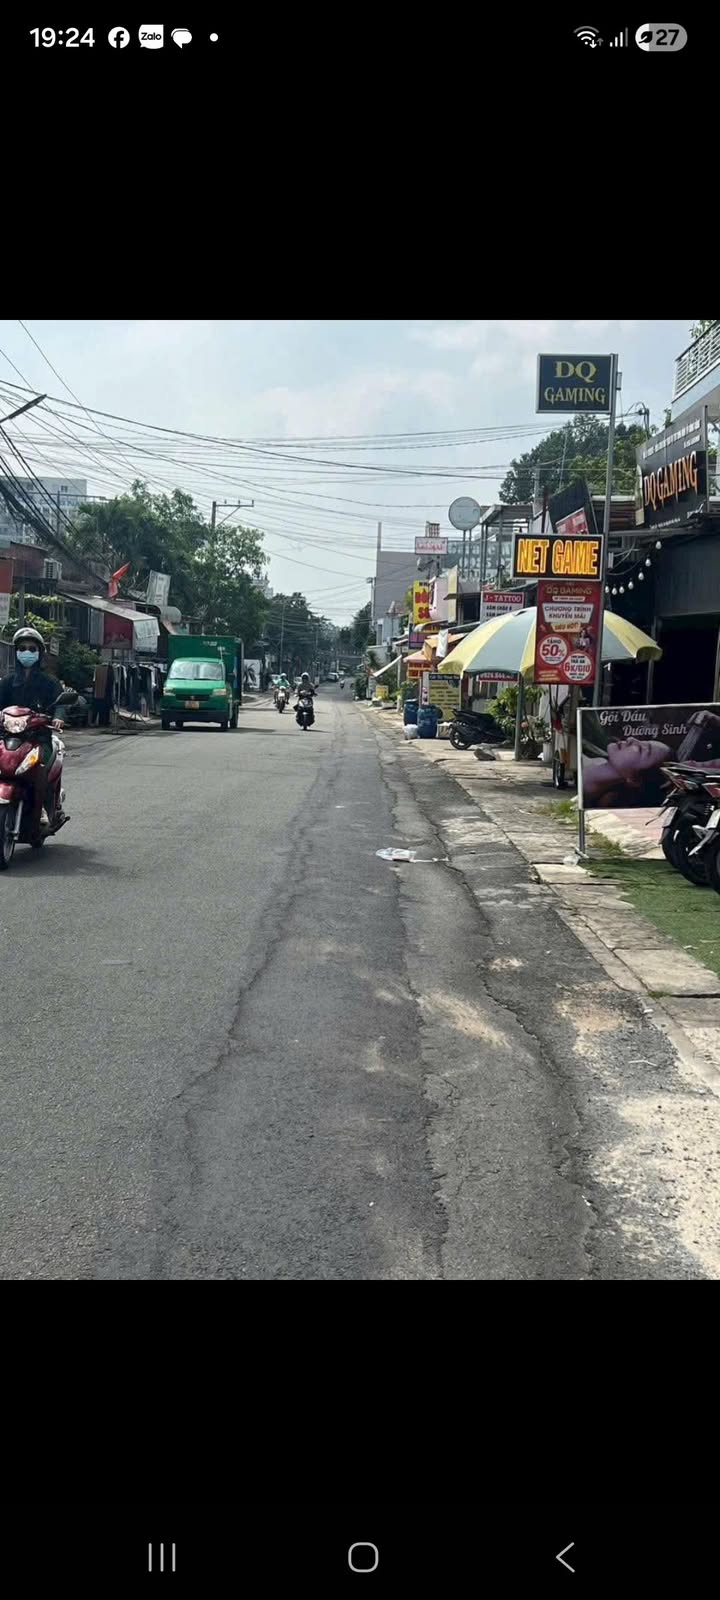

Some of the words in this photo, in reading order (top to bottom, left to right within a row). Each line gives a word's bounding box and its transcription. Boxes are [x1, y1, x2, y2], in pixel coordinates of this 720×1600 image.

[554, 361, 596, 383] DQ
[544, 387, 606, 405] GAMING
[657, 450, 698, 508] GAMING
[517, 538, 549, 573] NET
[552, 539, 599, 575] GAME
[494, 594, 522, 602] TATTOO
[560, 586, 593, 596] GAMING
[542, 644, 565, 657] 50%
[600, 711, 619, 726] Gội
[662, 723, 688, 735] Sinh
